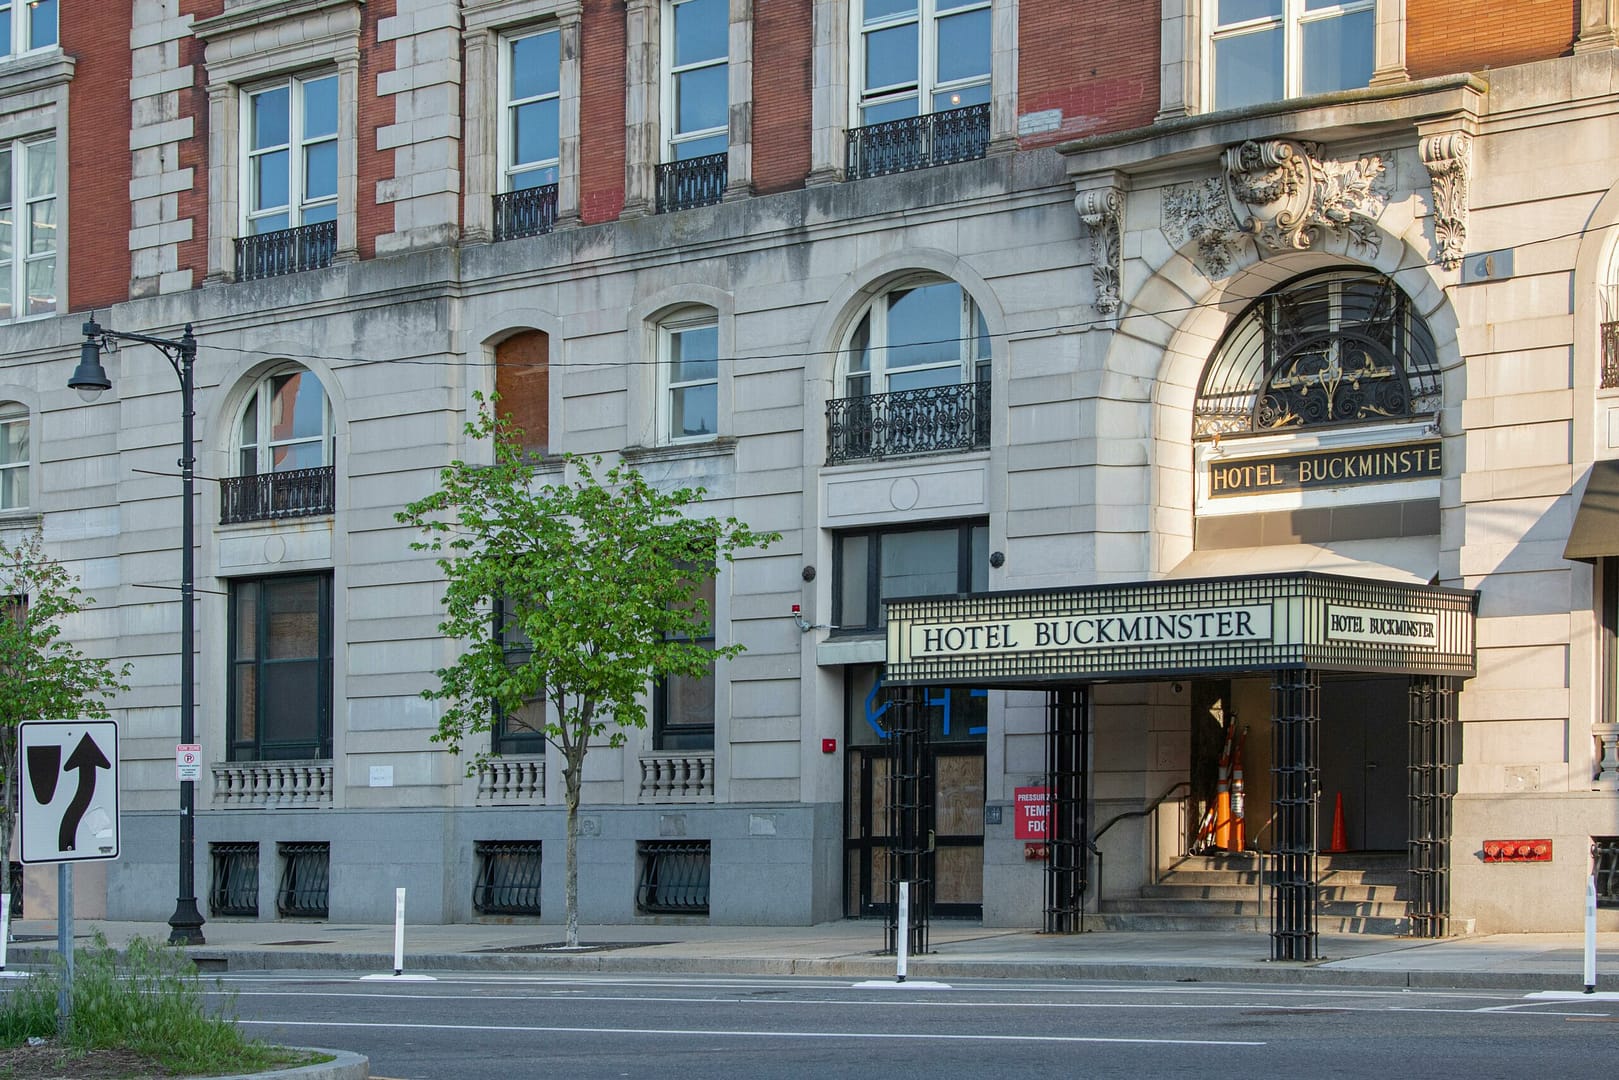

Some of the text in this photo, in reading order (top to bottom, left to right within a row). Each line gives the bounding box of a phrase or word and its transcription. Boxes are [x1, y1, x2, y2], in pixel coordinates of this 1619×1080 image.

[1213, 448, 1441, 490] HOTEL BUCKMINSTE
[923, 610, 1256, 652] HOTEL BUCKMINSTER
[1330, 614, 1434, 638] HOTEL BUCKMINSTER
